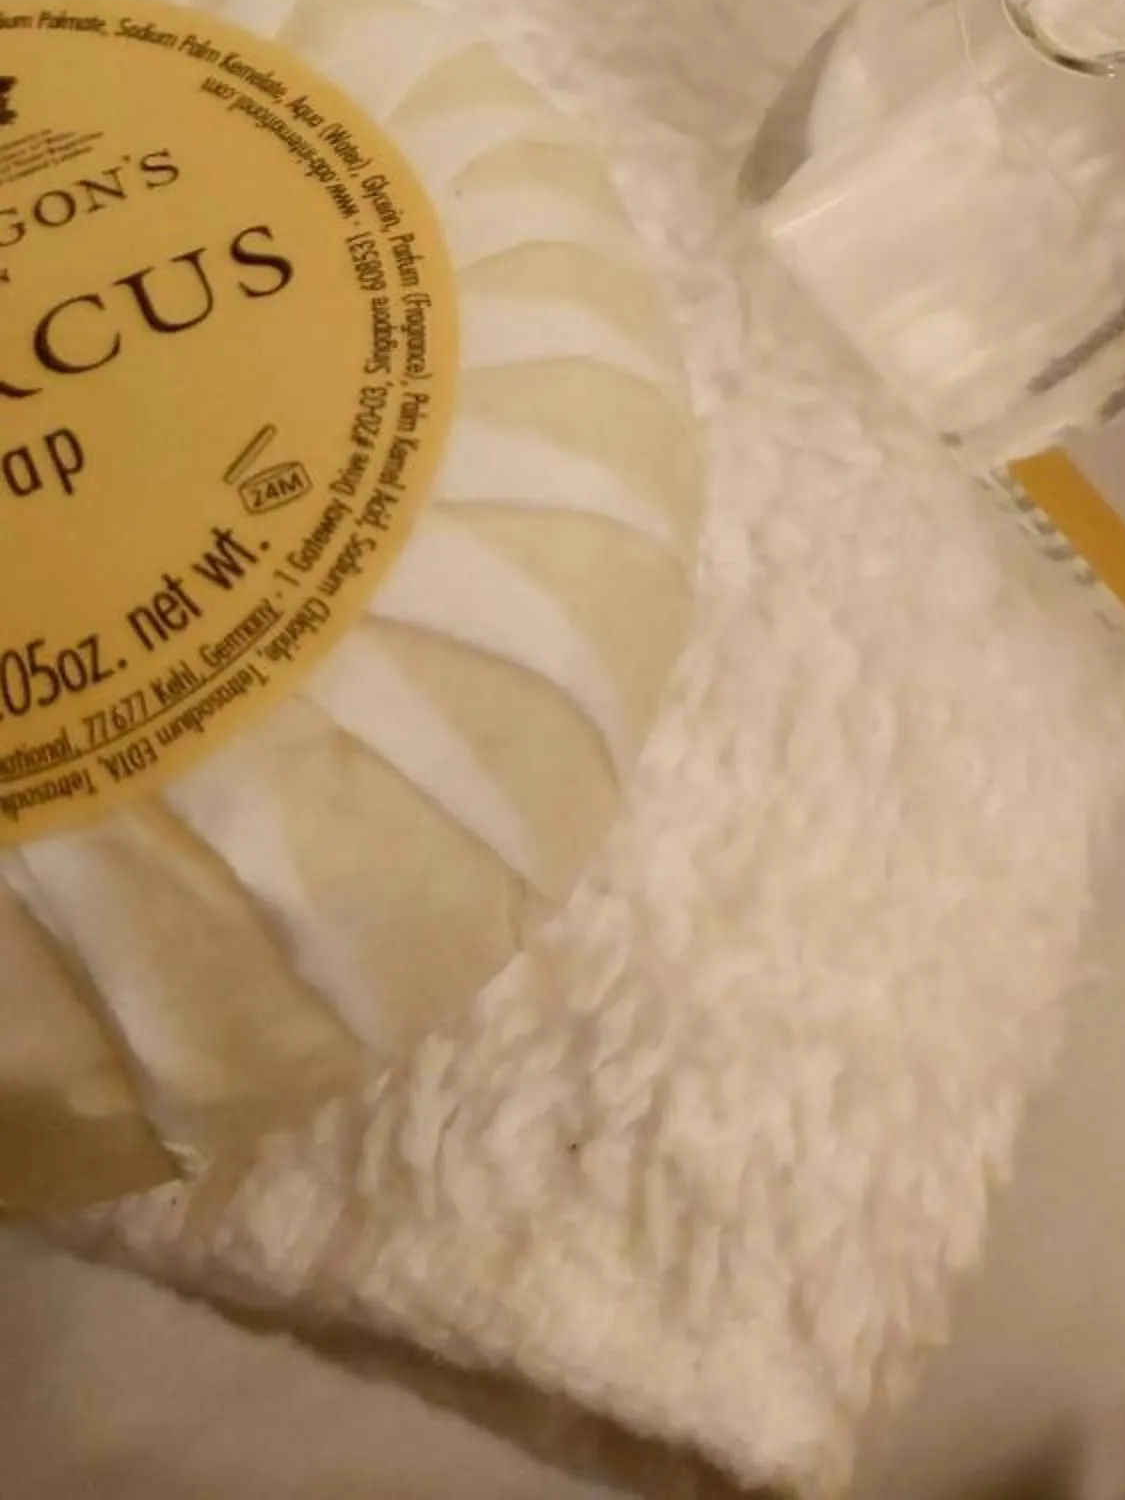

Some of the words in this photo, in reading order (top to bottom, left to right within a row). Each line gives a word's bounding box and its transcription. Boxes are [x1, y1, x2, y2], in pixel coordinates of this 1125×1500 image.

[114, 17, 177, 48] Sodium
[178, 34, 221, 63] Palm
[285, 95, 325, 129] Aqua
[346, 232, 387, 291] 608531
[388, 233, 424, 287] Parfum
[364, 296, 399, 374] Singapore
[400, 293, 433, 386] (Fragrance),
[397, 392, 431, 432] Palm
[2, 427, 84, 497] ap
[250, 470, 304, 508] 24M
[329, 451, 369, 496] Drive
[378, 435, 420, 490] Kernel
[287, 498, 353, 572] Gateway
[317, 532, 377, 596] Sodium
[126, 573, 202, 652] net
[190, 525, 271, 591] wt.
[199, 598, 280, 667] Germany
[256, 597, 331, 661] Chloride,
[82, 690, 148, 747] 77677
[155, 663, 270, 747] Tetrasodium
